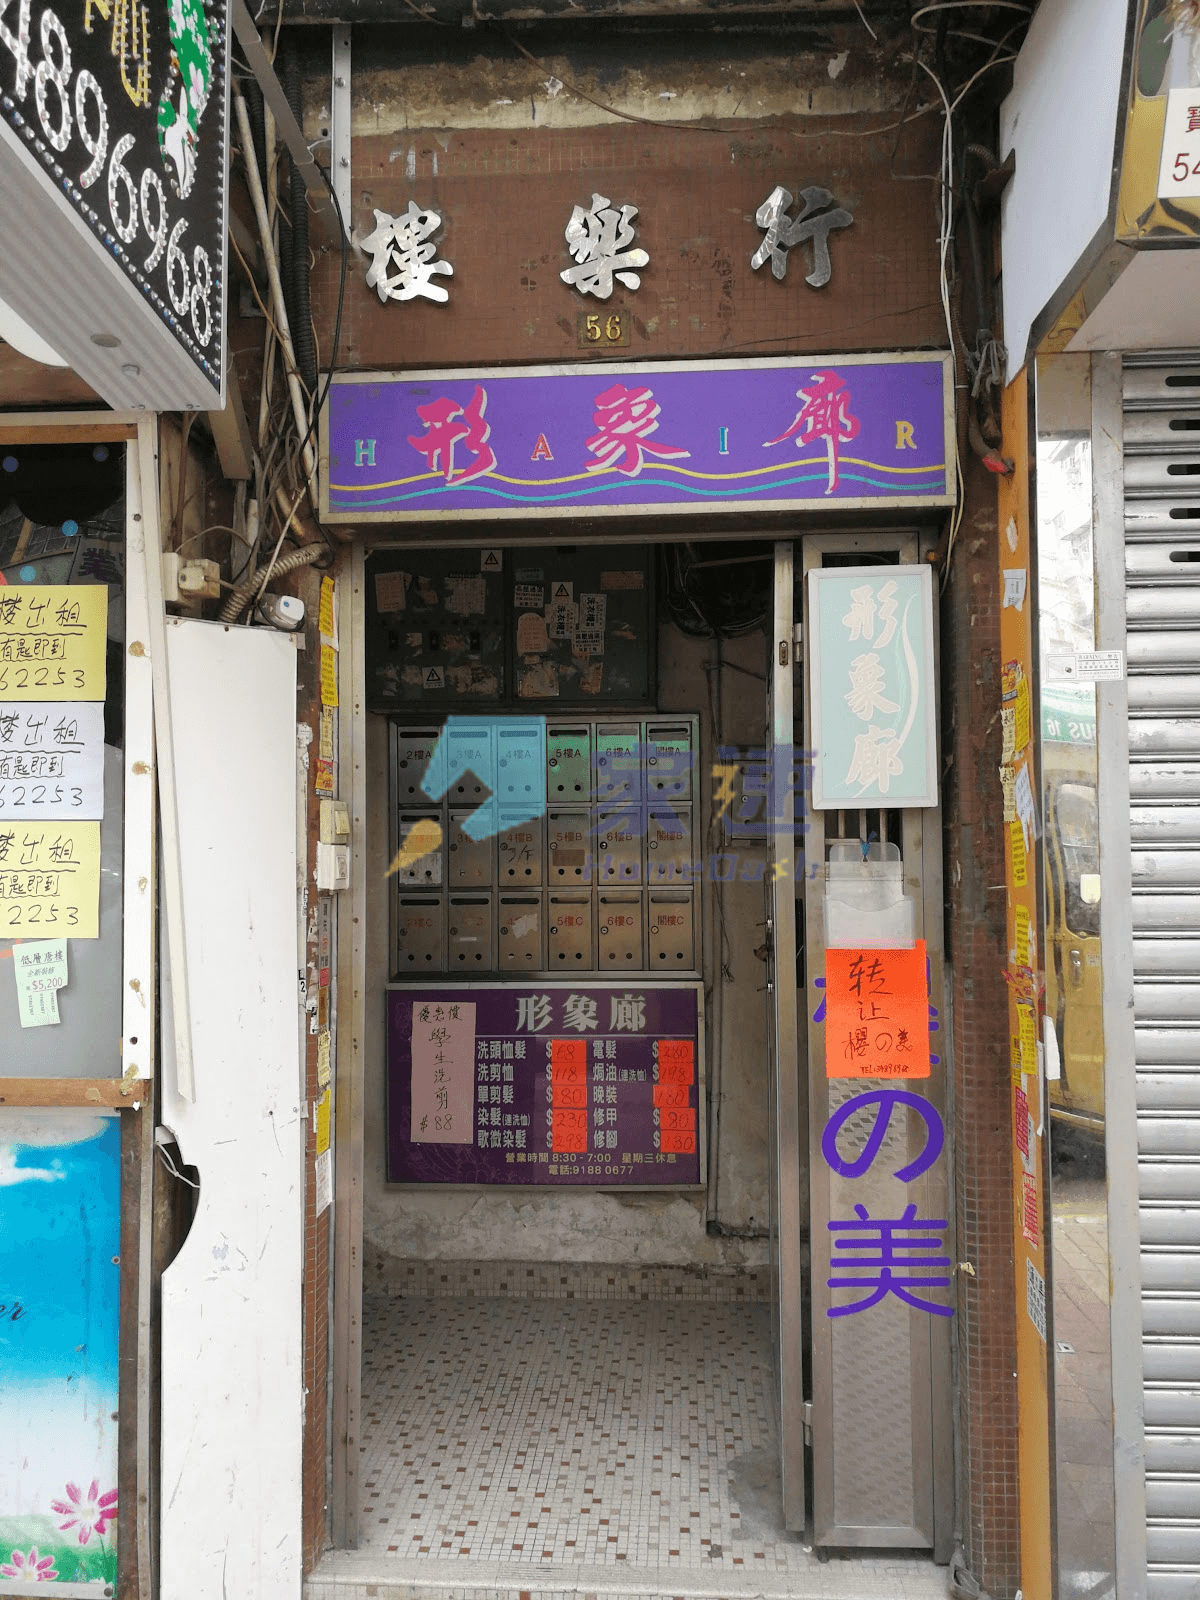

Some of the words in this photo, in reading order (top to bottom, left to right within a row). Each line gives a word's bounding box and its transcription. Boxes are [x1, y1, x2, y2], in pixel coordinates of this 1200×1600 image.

[586, 315, 622, 340] 56
[407, 371, 861, 495] 形象廊
[841, 580, 904, 799] 形象廊
[555, 748, 582, 759] 5樓A
[506, 832, 533, 843] 4樓B
[556, 831, 583, 842] 5樓B
[606, 831, 632, 842] 6樓B
[557, 916, 584, 927] 5樓C
[607, 915, 634, 926] 6樓C
[32, 977, 62, 991] $5,200
[515, 994, 648, 1033] 形象廊
[477, 1040, 527, 1060] 洗頭恤髮
[592, 1039, 616, 1060] 電髮
[477, 1063, 514, 1082] 洗剪恤
[477, 1085, 514, 1105] 單剪髮
[593, 1084, 617, 1104] 晚裝
[593, 1107, 617, 1126] 修甲
[505, 1152, 549, 1164] 營業時間
[552, 1153, 577, 1163] 8:30
[587, 1153, 611, 1163] 7:00
[621, 1152, 677, 1164] 星期三休息
[604, 1165, 634, 1175] 0677
